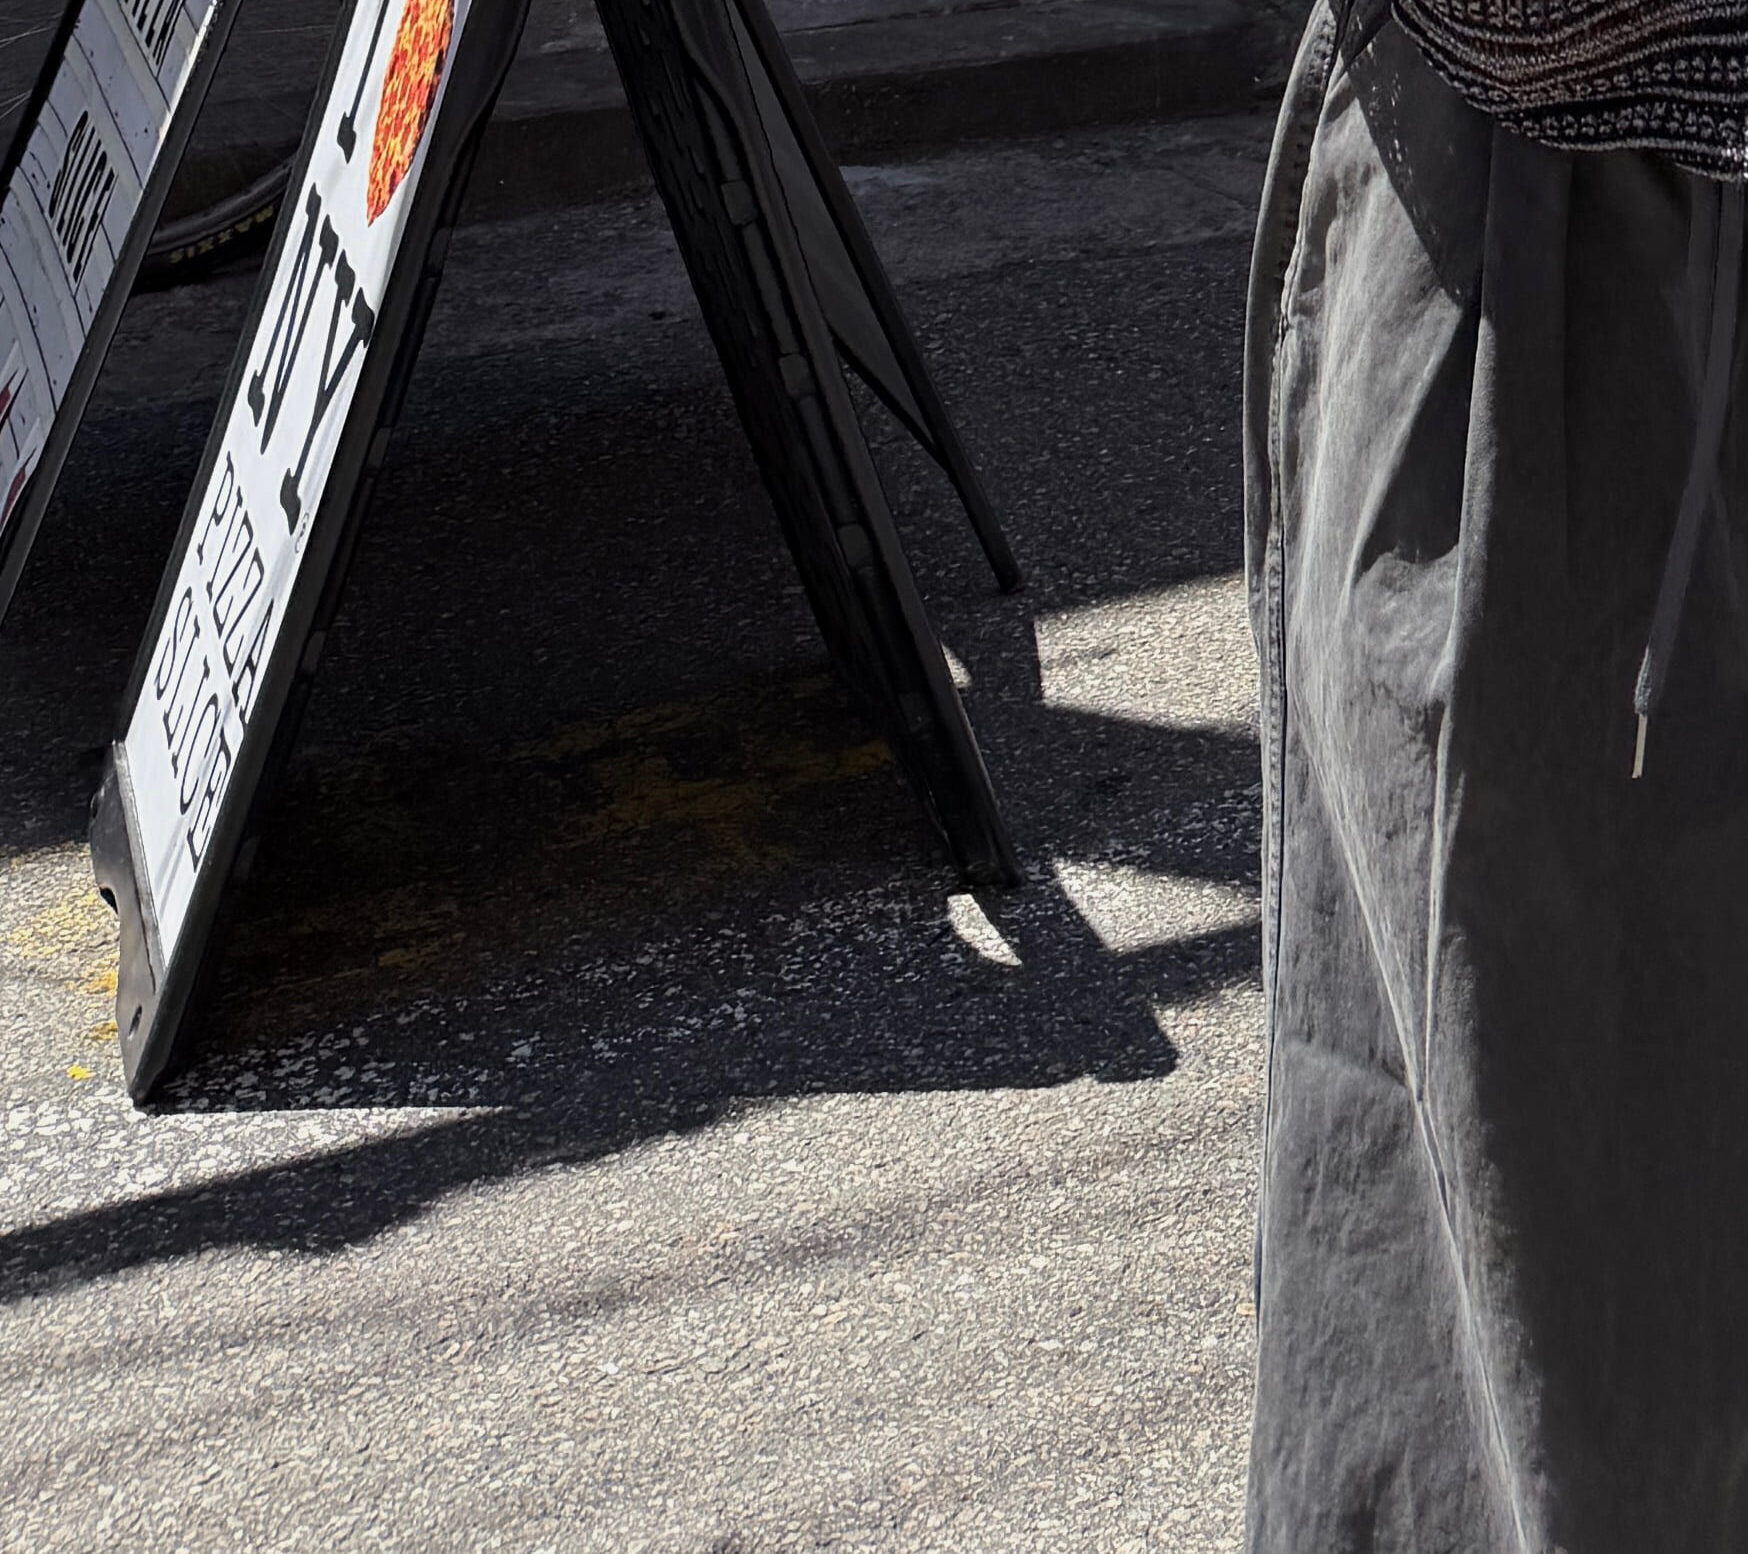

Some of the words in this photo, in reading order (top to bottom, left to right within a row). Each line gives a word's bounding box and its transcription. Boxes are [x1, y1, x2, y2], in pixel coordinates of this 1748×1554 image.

[49, 110, 116, 283] SLICE
[247, 182, 375, 536] NY
[198, 451, 274, 724] PIZZA
[156, 587, 232, 872] SLICE
